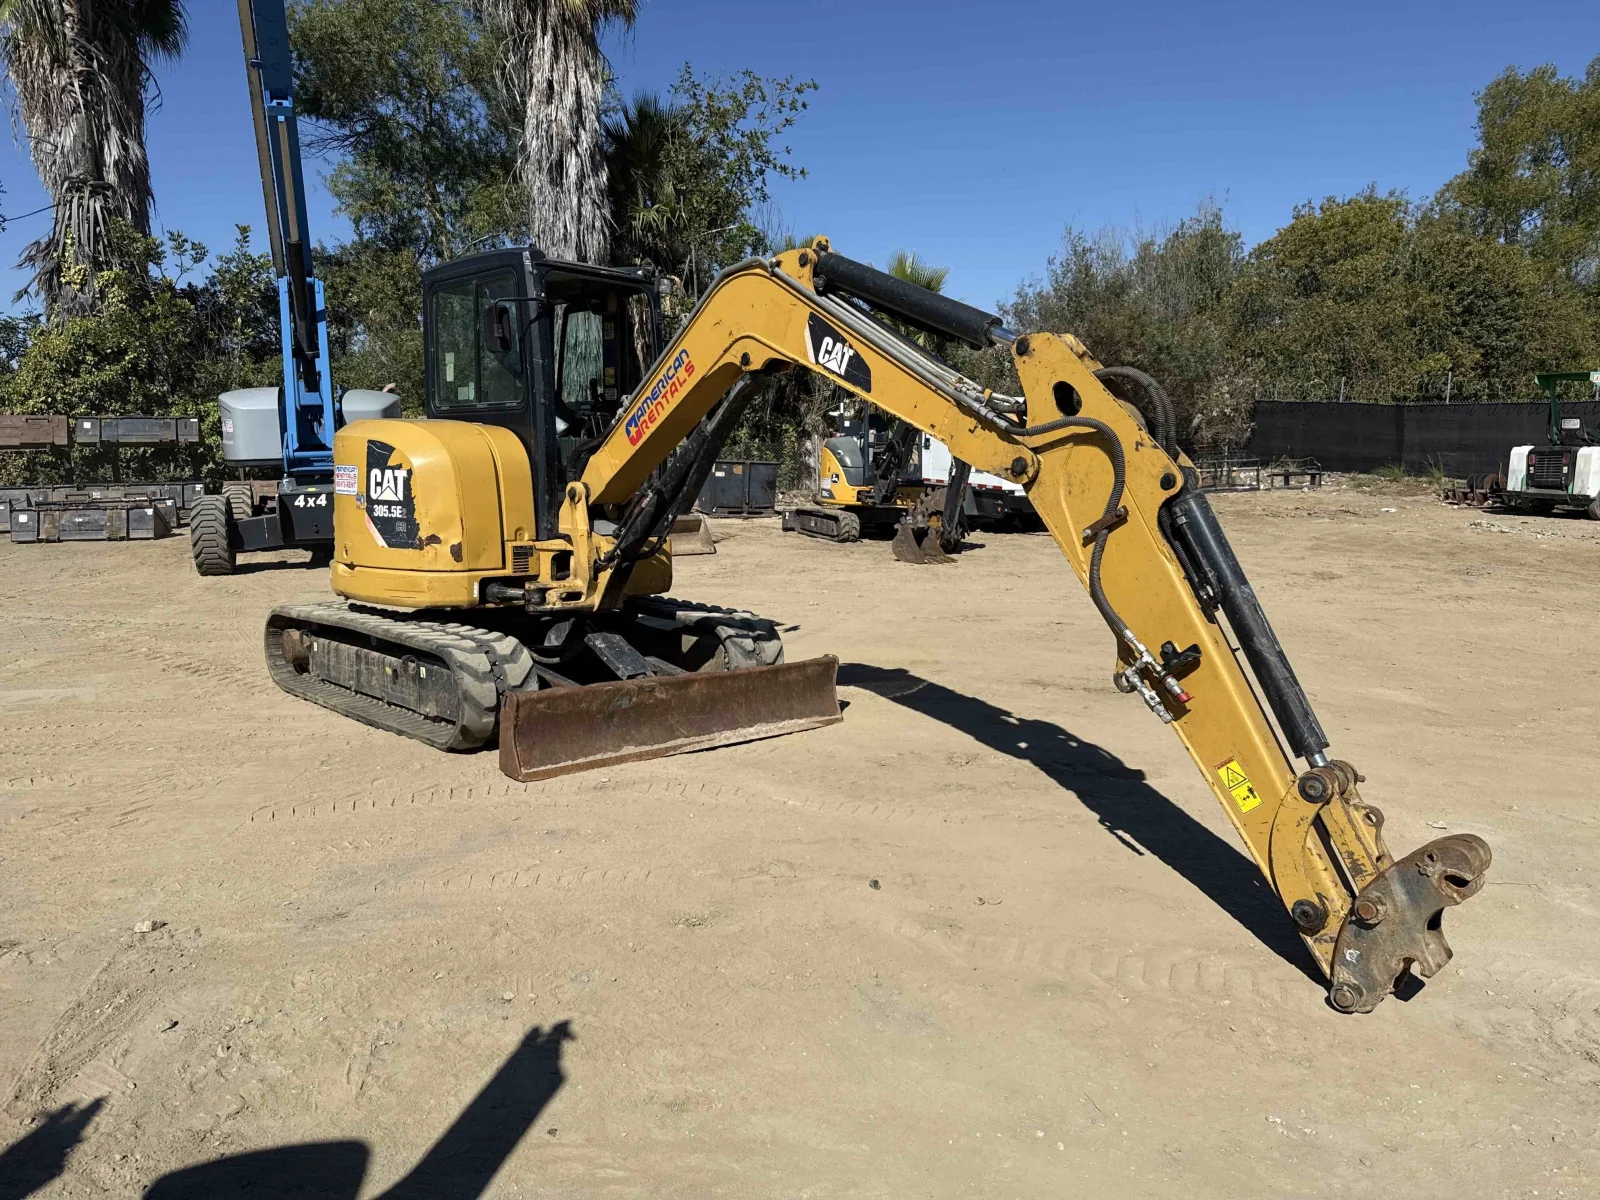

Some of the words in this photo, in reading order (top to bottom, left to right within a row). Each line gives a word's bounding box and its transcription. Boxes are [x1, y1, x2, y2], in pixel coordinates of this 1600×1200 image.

[818, 337, 855, 376] CAT
[635, 349, 690, 422] AMERICAN
[639, 360, 695, 435] RENTALS
[294, 493, 327, 508] 4x4
[370, 468, 407, 501] CAT
[373, 504, 407, 519] 305.5E2
[396, 521, 407, 532] CR
